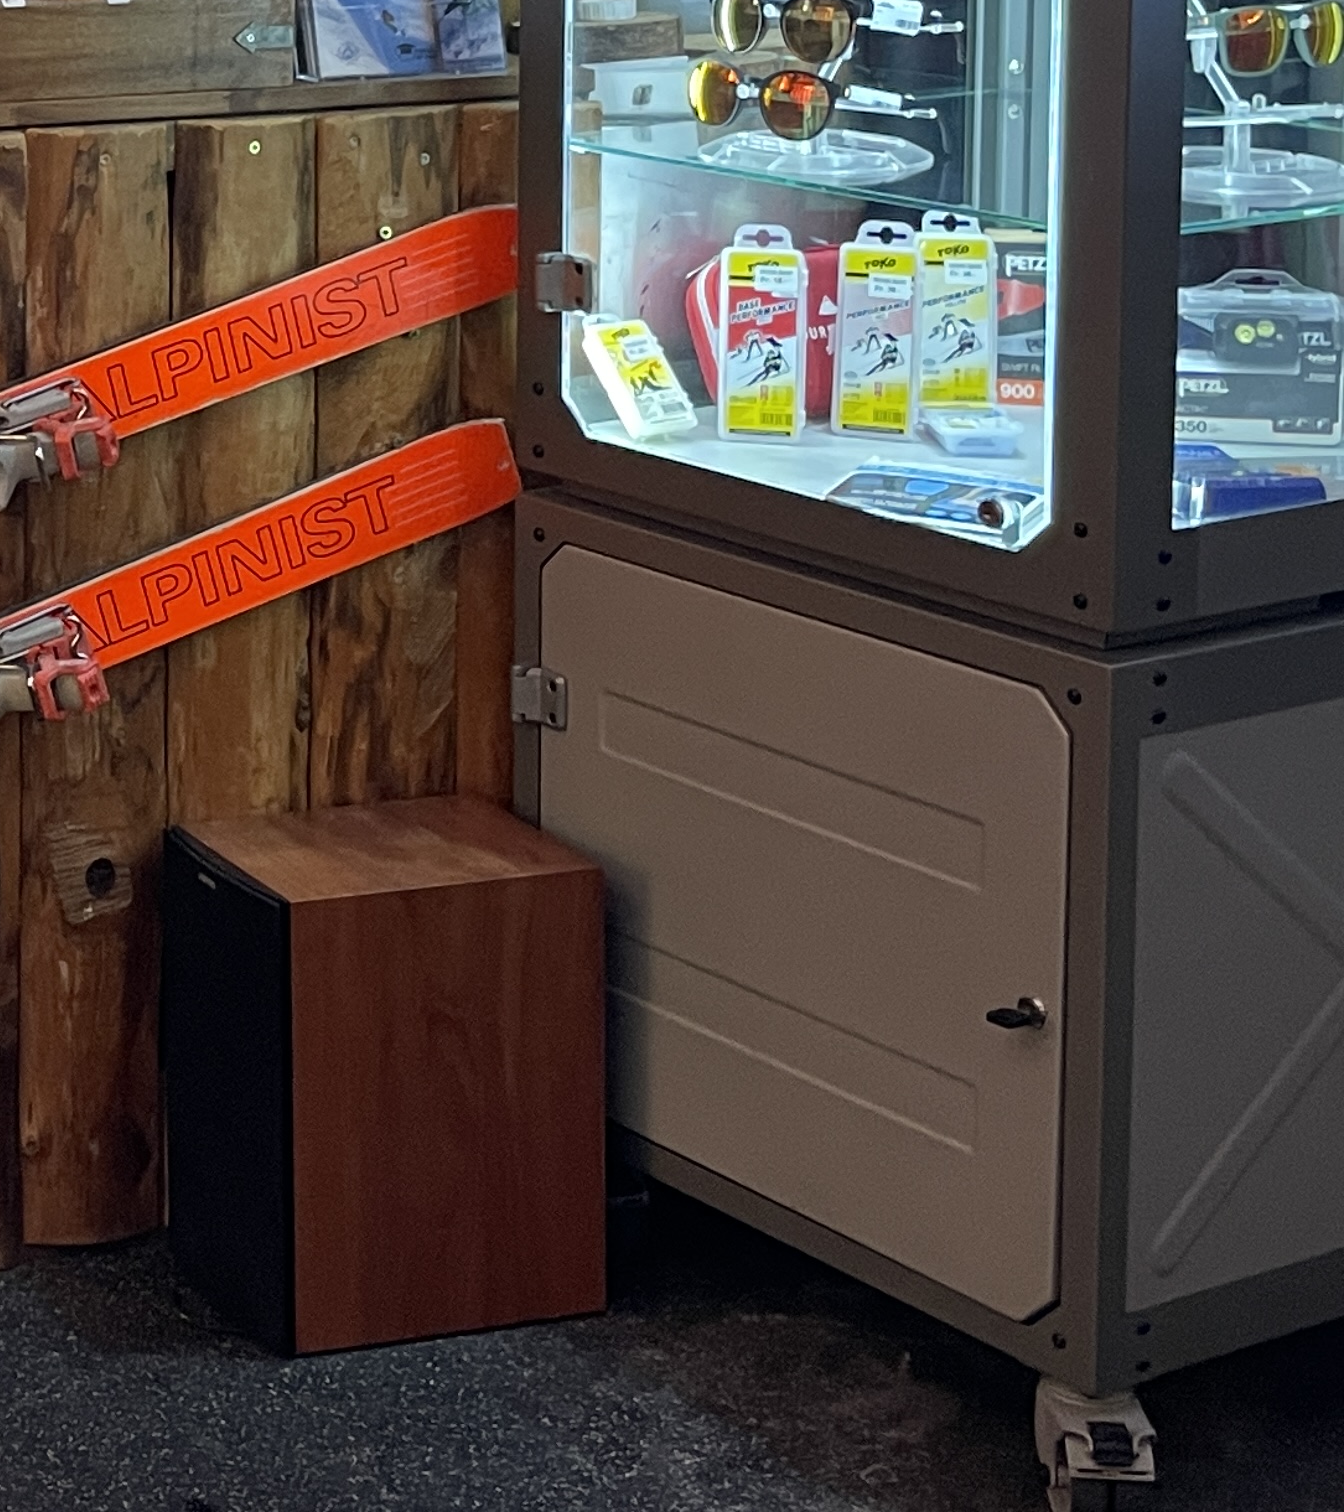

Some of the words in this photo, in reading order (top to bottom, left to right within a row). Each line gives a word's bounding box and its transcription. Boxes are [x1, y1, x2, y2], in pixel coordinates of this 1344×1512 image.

[937, 244, 971, 258] TOKO
[863, 256, 898, 270] TOKO
[1004, 253, 1048, 277] PETZ
[999, 382, 1036, 399] 900
